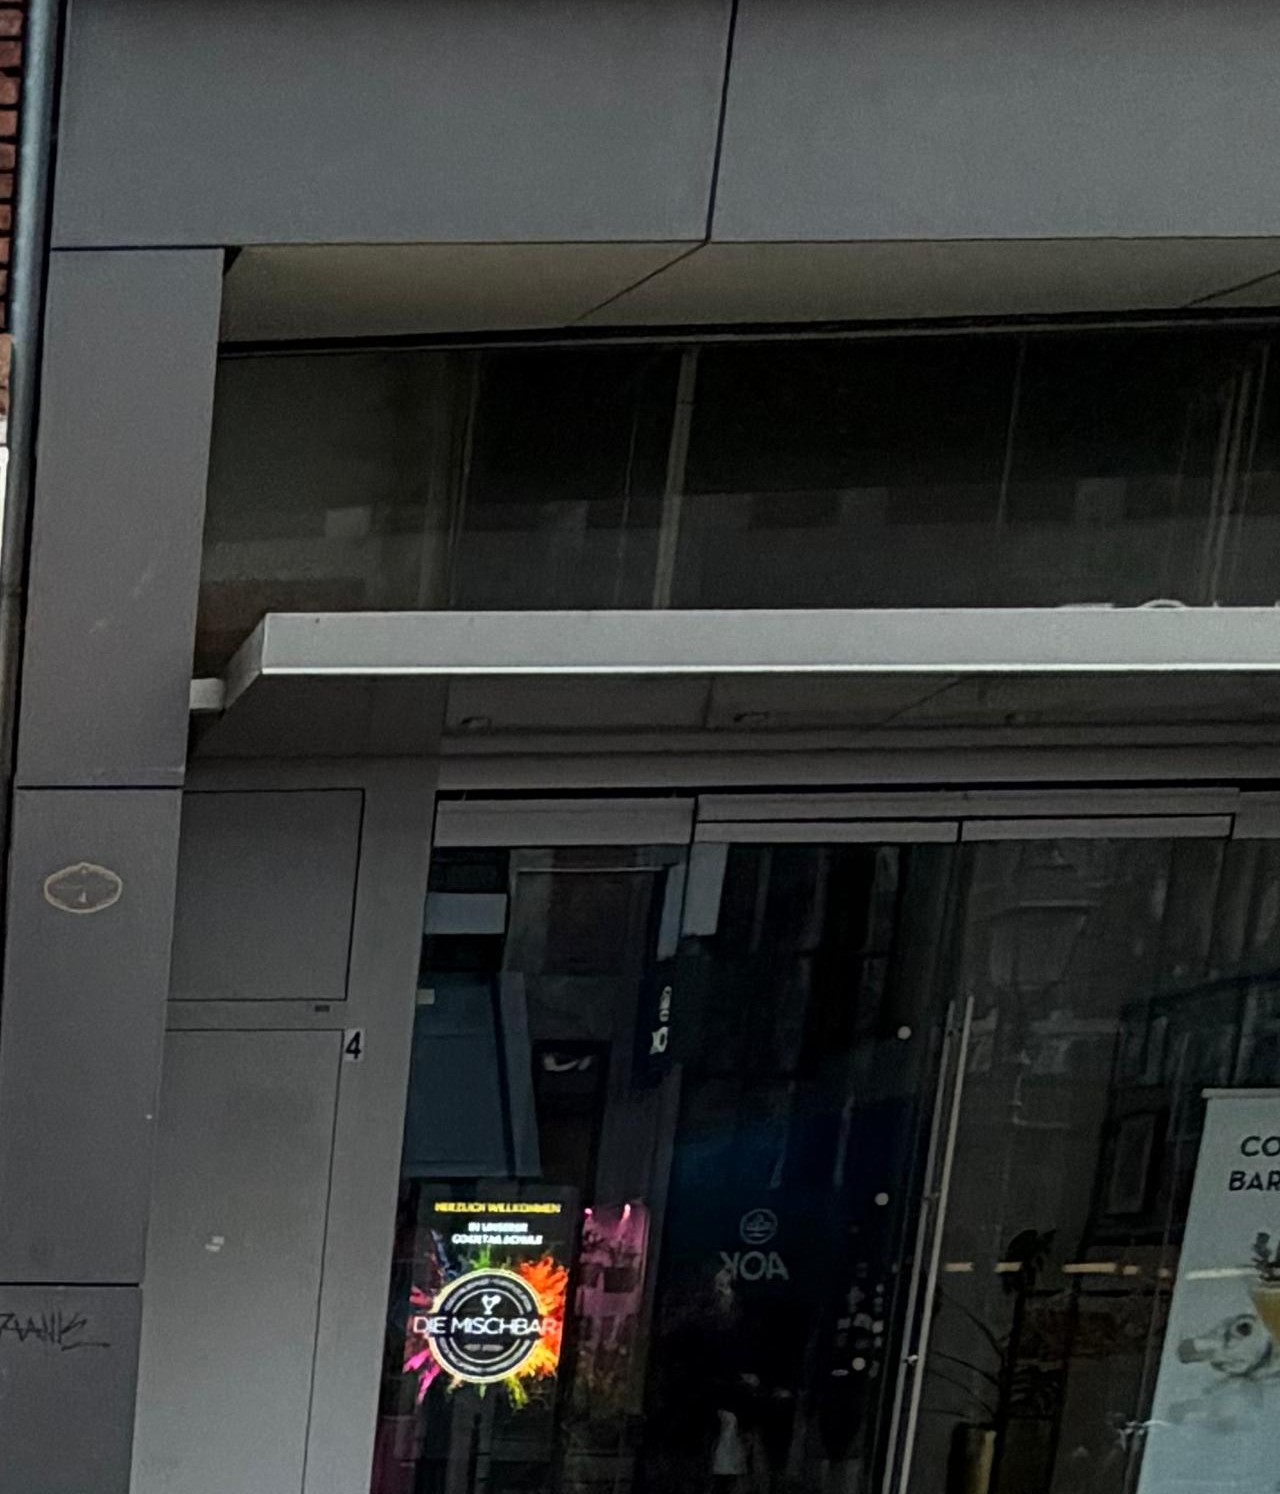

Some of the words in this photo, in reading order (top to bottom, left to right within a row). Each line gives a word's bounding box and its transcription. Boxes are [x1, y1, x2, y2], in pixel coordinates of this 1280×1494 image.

[345, 1031, 362, 1060] 4
[413, 1316, 447, 1334] DIE
[451, 1316, 558, 1335] MISCHBAR
